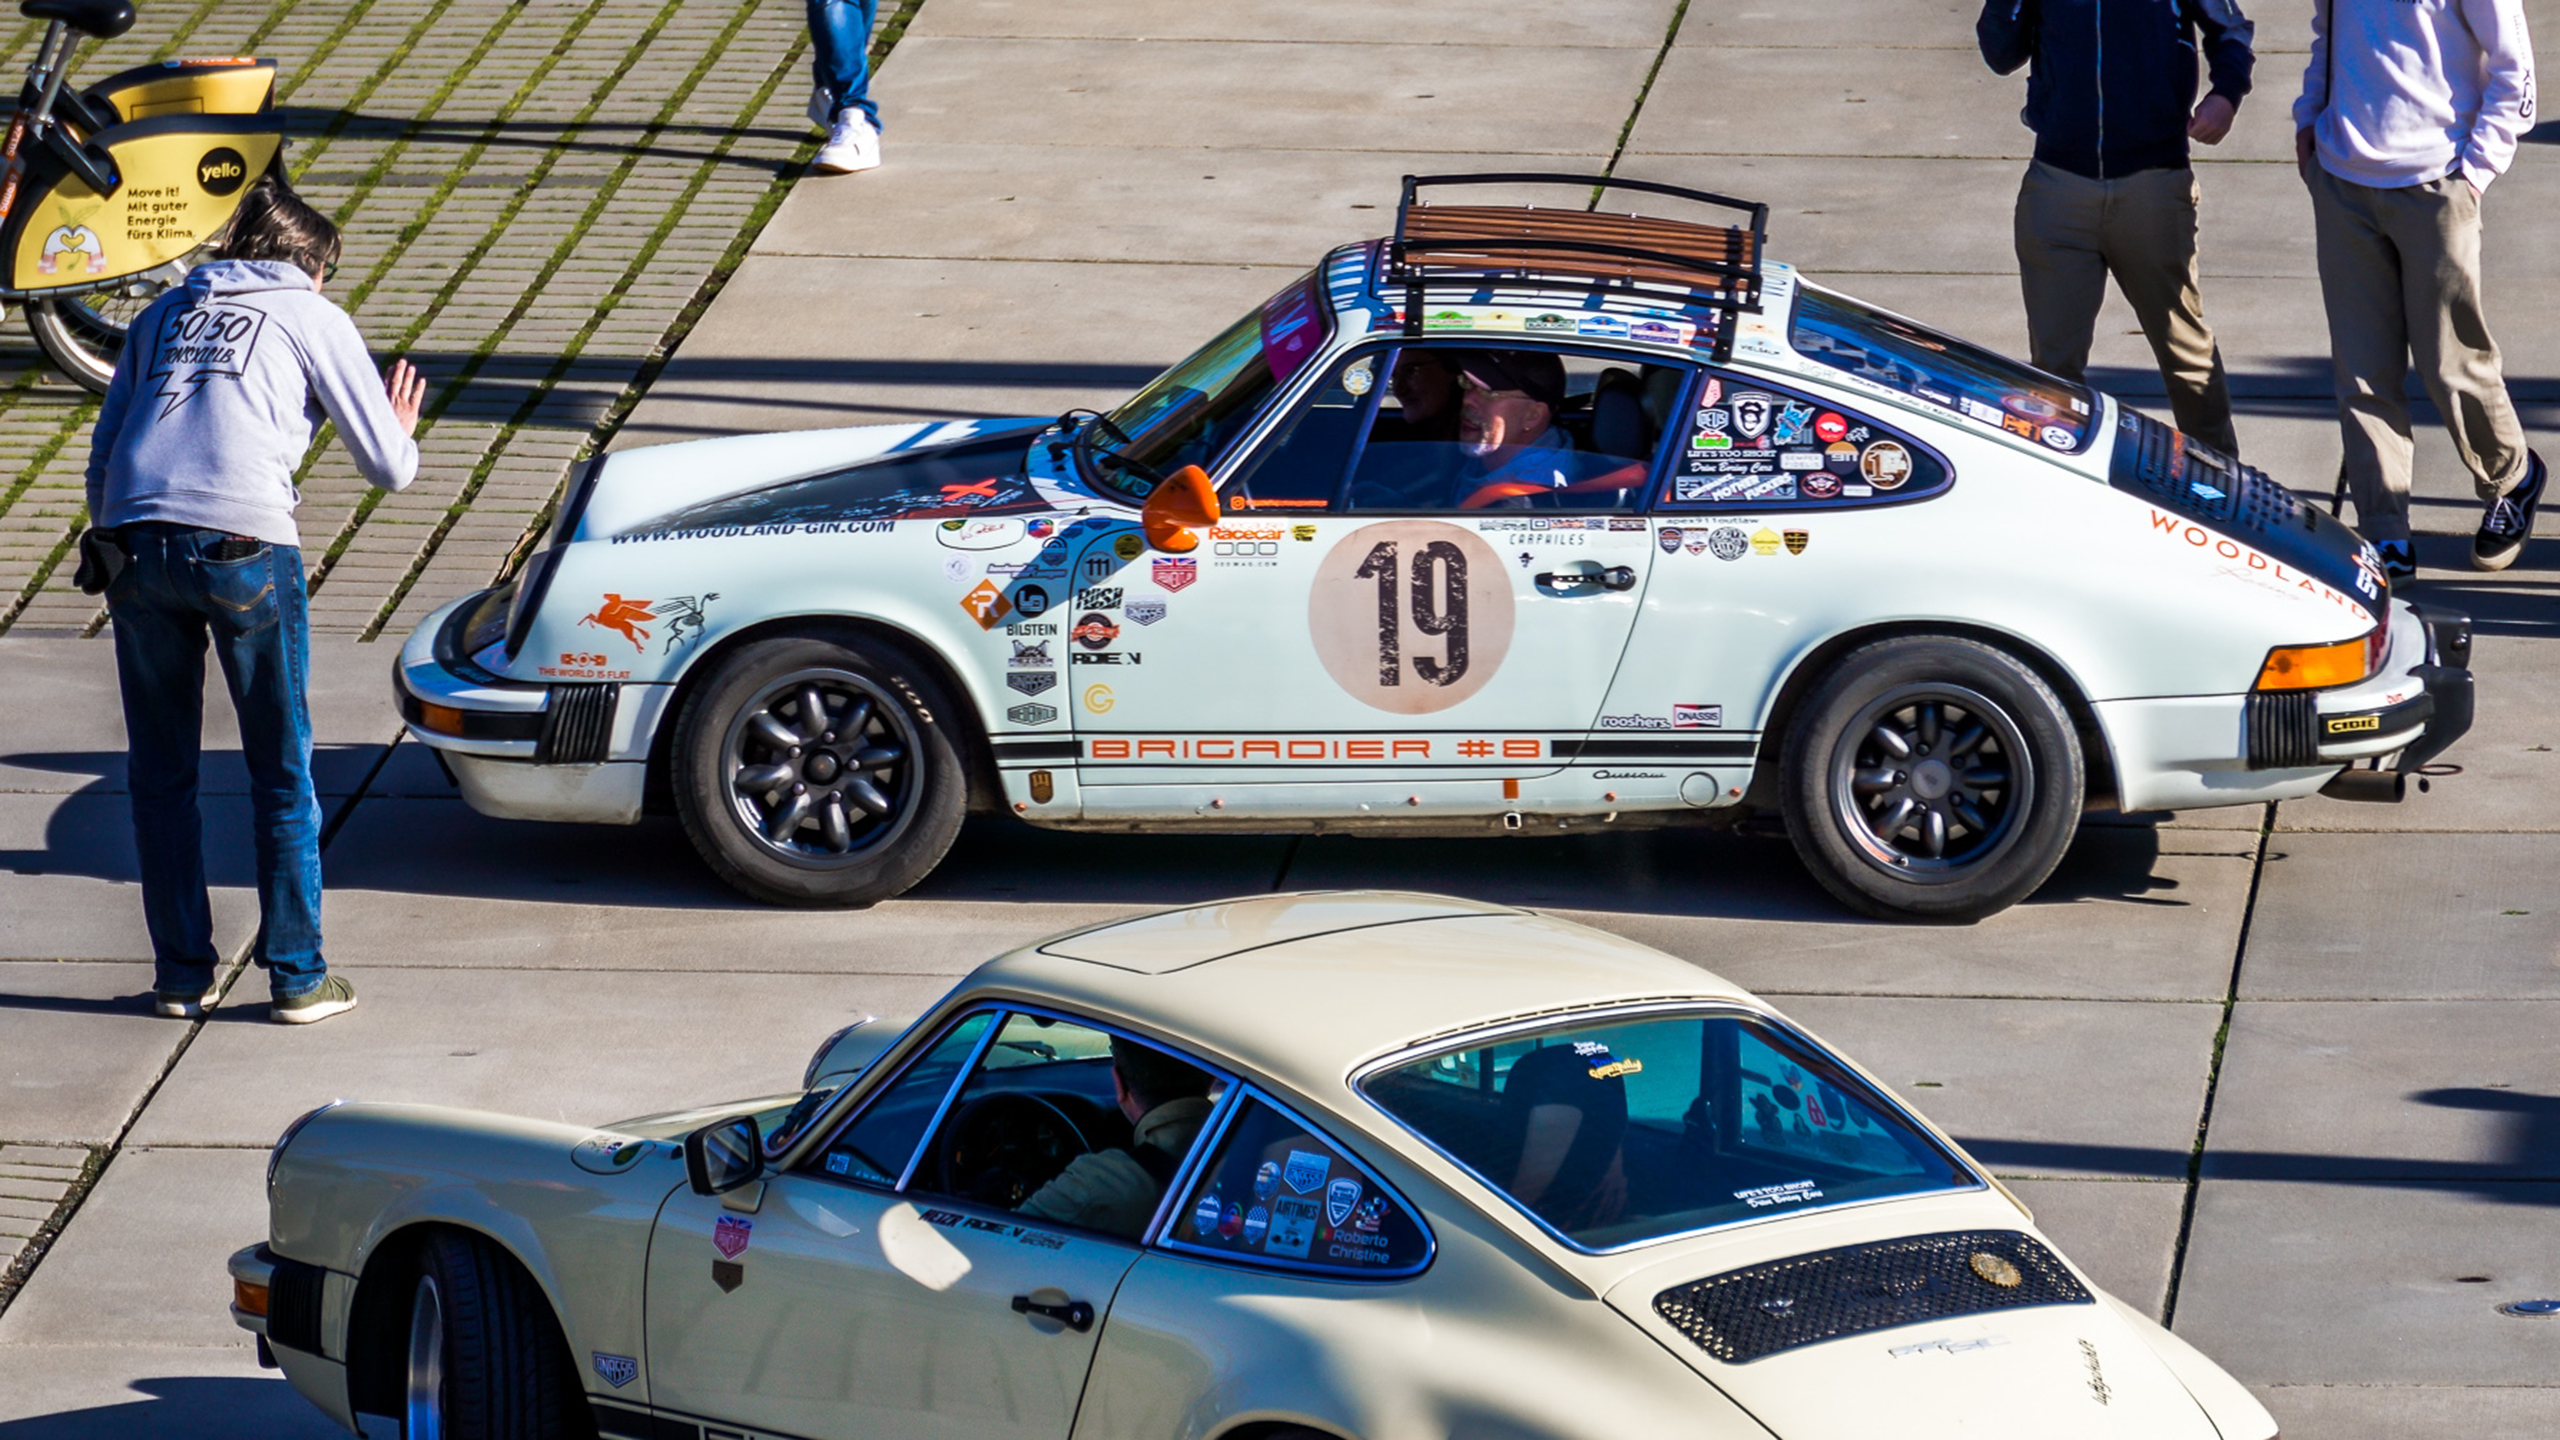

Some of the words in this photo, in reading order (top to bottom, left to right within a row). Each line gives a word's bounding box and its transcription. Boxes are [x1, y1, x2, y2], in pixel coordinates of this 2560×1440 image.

[201, 162, 241, 183] yello
[127, 188, 162, 199] Move
[165, 187, 180, 198] it!
[127, 202, 148, 213] Mit
[152, 202, 188, 215] guter
[127, 215, 178, 229] Energie
[127, 229, 153, 240] fürs
[164, 310, 254, 344] 50/50
[1719, 450, 1742, 458] TOO
[610, 520, 898, 546] WWW.WOODLAND-GIN.COM
[1208, 526, 1286, 541] Racecar
[2150, 509, 2369, 621] WOODLAND
[1353, 540, 1469, 688] 19
[1006, 623, 1058, 636] BILSTEIN
[537, 666, 557, 677] THE
[558, 668, 595, 679] WORLD
[596, 669, 606, 679] IS
[607, 670, 632, 680] FLAT
[1676, 711, 1720, 722] ONASSIS
[1091, 739, 1431, 760] BRIGADIER
[1456, 738, 1541, 759] #8
[1275, 1199, 1319, 1222] AIRTIMES
[1333, 1229, 1389, 1249] Roberto
[1328, 1244, 1391, 1265] Christine
